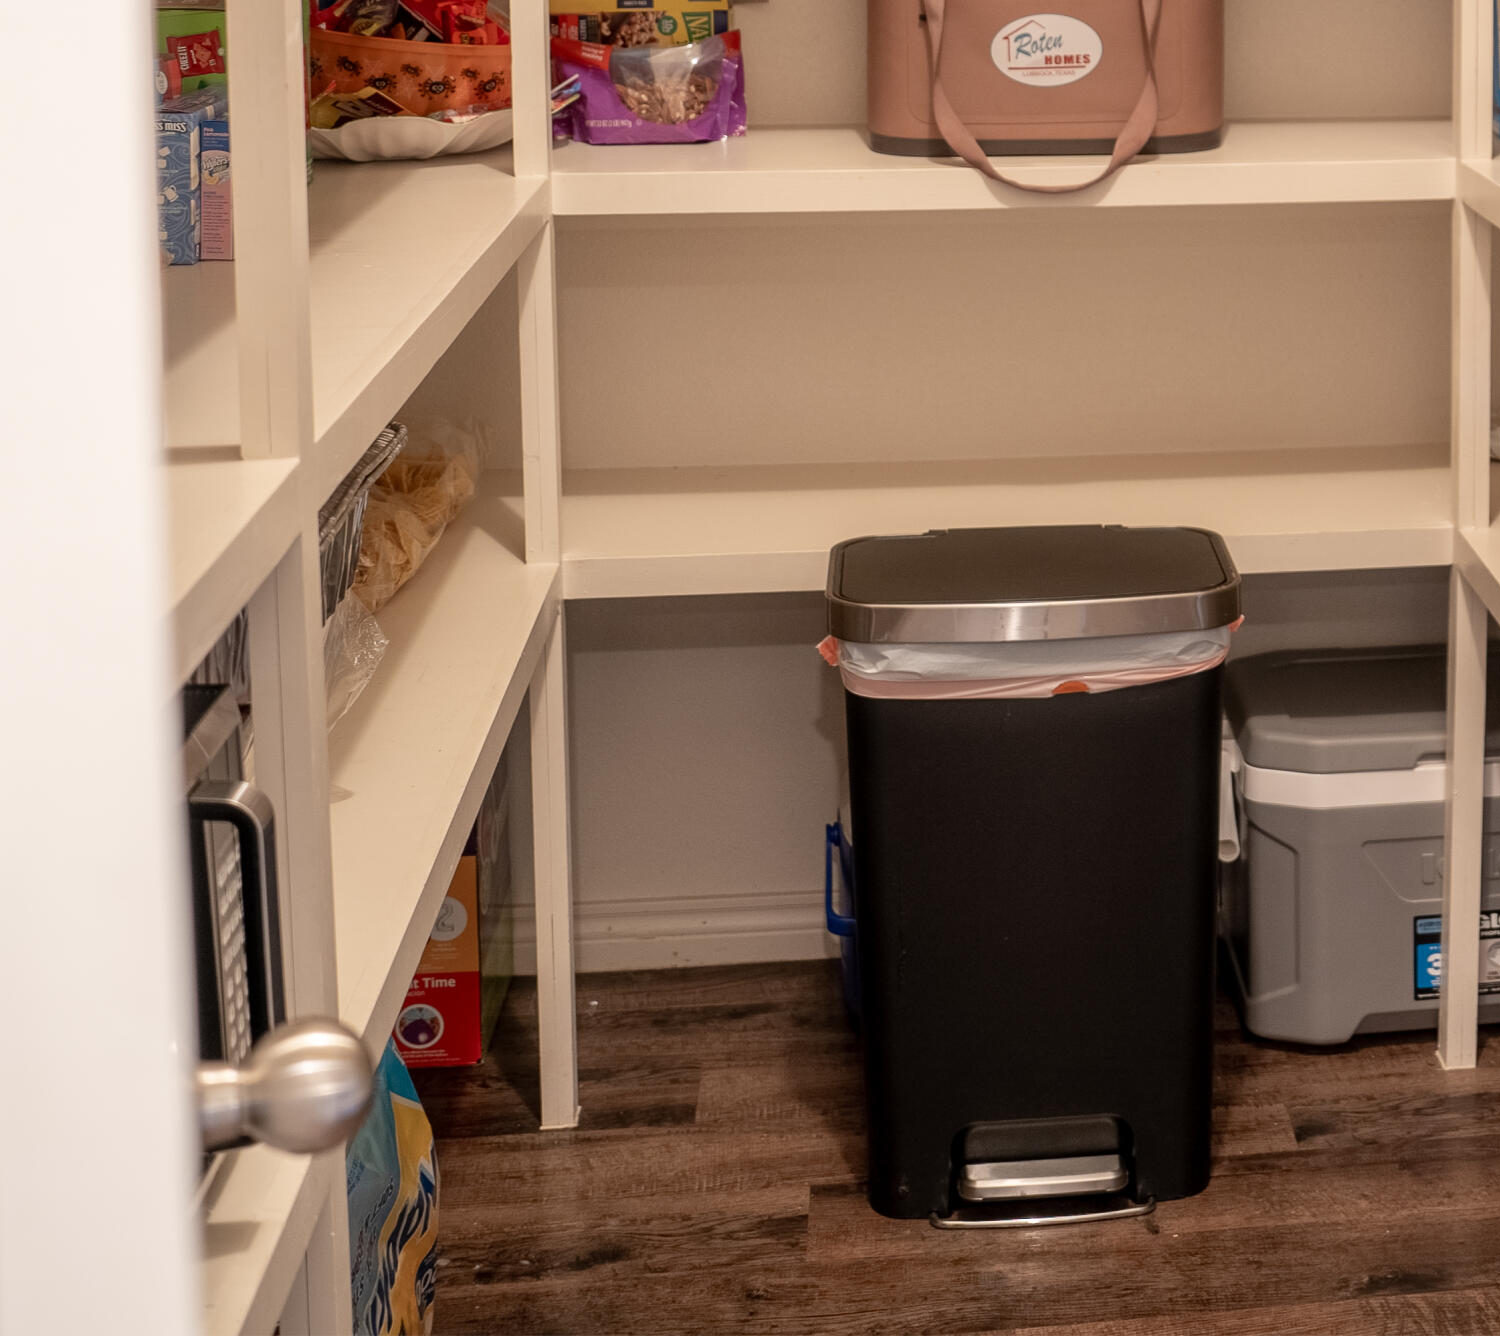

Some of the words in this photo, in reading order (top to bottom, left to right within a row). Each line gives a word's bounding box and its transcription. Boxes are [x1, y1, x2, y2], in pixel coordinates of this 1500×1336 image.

[1014, 32, 1063, 60] Roten
[1044, 54, 1091, 65] HOMES
[421, 977, 456, 989] Time
